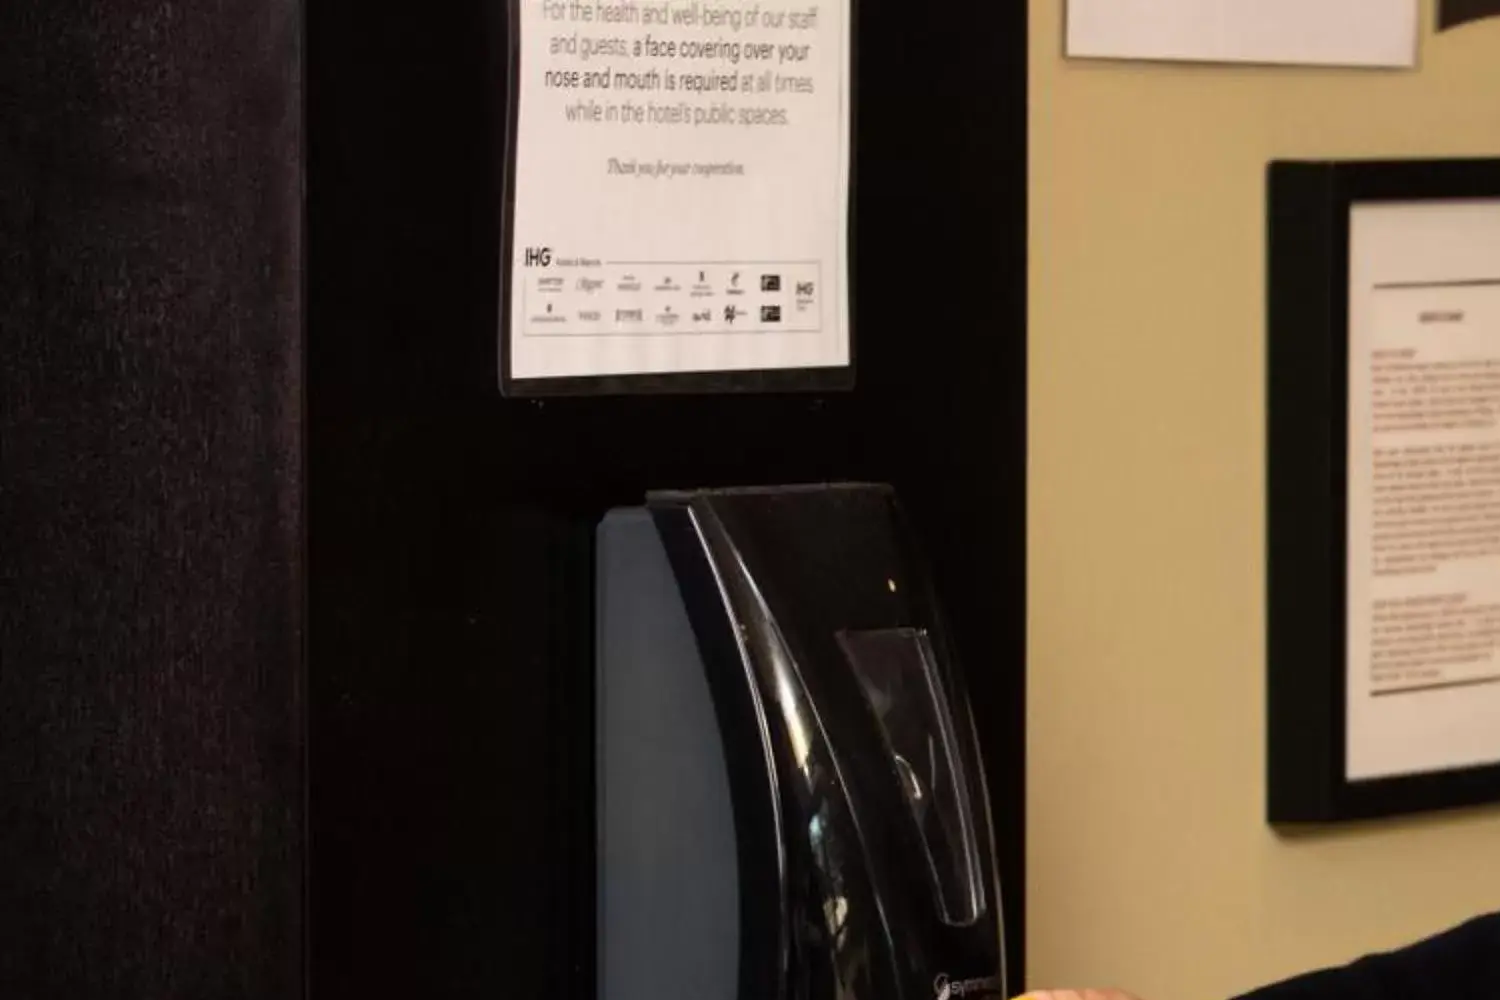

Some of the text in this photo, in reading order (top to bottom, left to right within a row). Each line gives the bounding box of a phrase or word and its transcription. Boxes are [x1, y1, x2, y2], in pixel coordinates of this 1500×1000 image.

[543, 0, 818, 32] For the health and well-being of our staff
[550, 33, 577, 55] and
[633, 40, 641, 57] a
[645, 34, 676, 57] face
[680, 38, 740, 64] covering
[743, 42, 774, 60] over
[777, 44, 810, 65] your
[544, 67, 813, 94] nose and mouth is required at all times
[565, 100, 602, 122] while
[604, 103, 619, 122] in
[621, 102, 645, 123] the
[648, 102, 691, 124] hotel's
[694, 103, 735, 126] public
[607, 157, 637, 176] Thank
[525, 247, 551, 267] IHG
